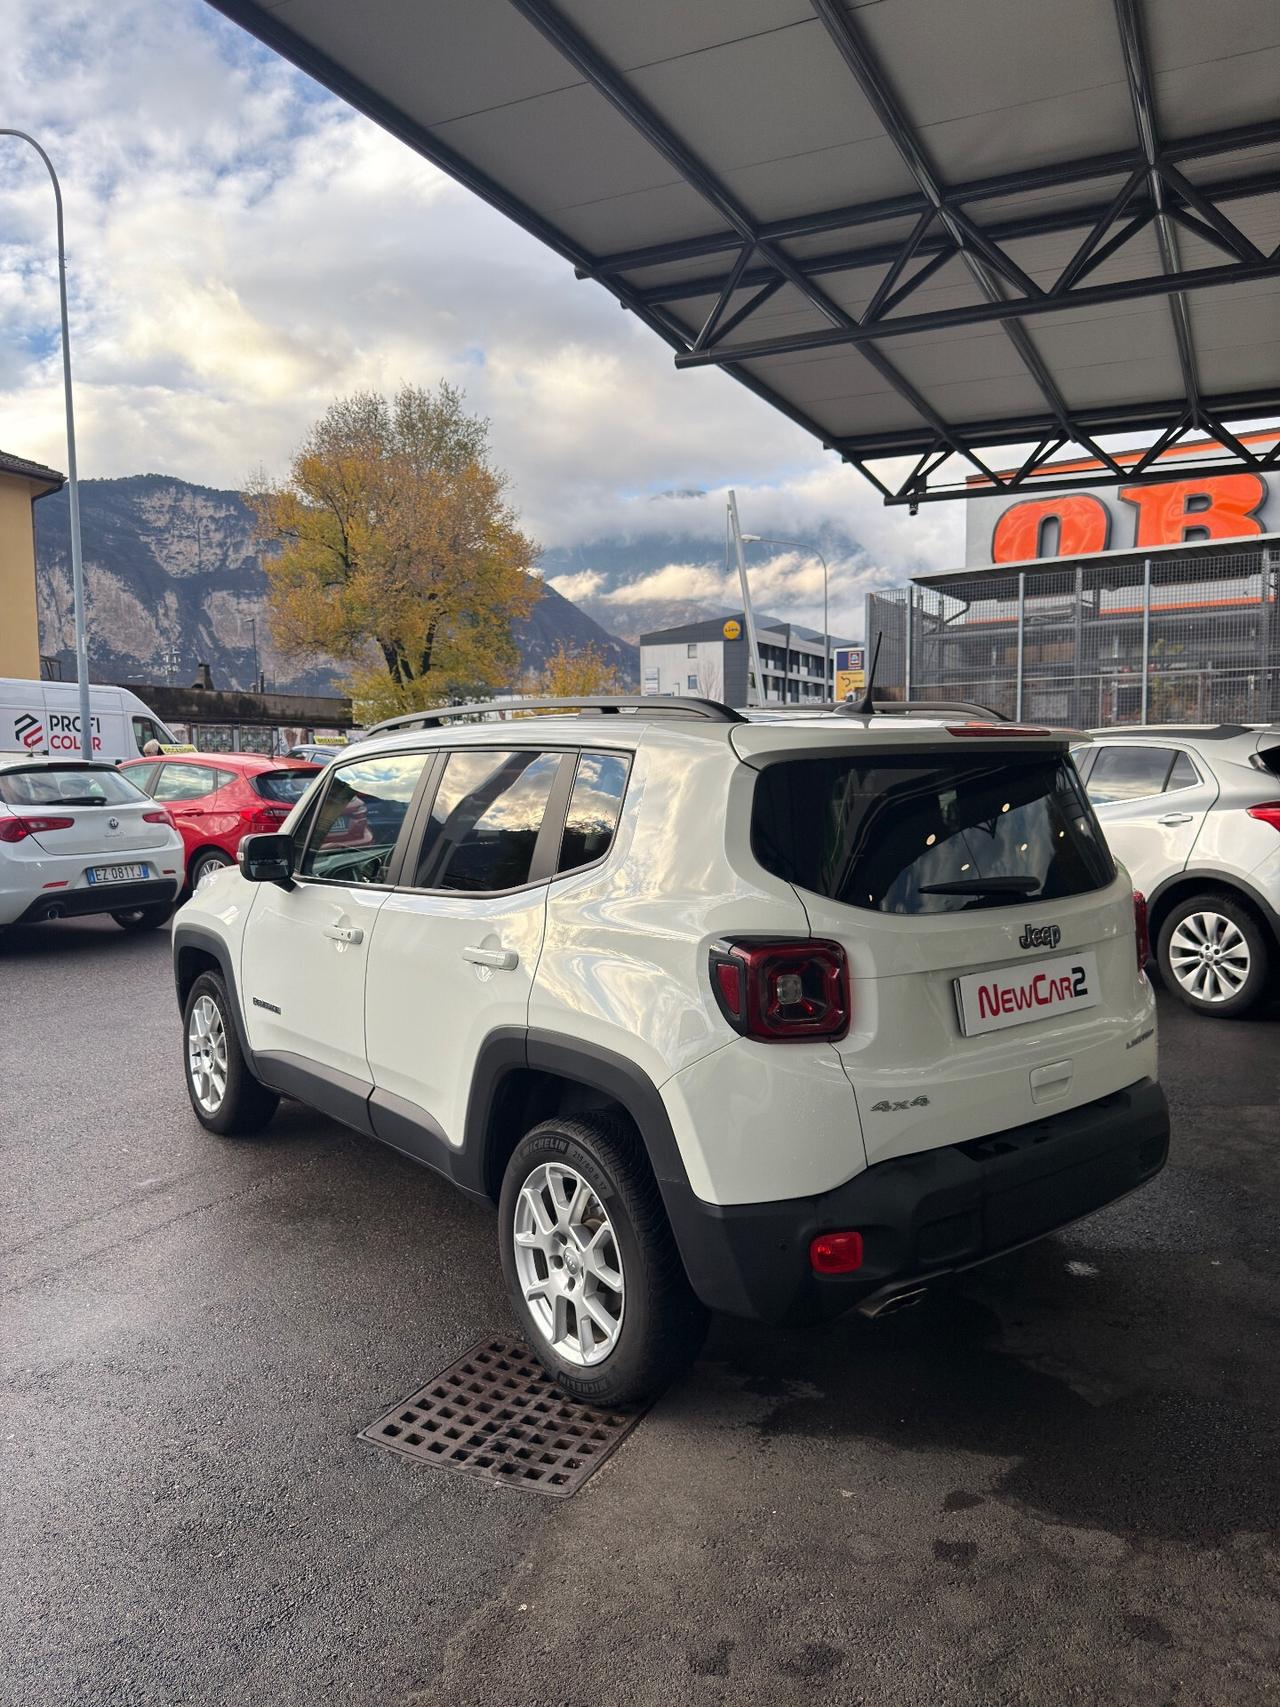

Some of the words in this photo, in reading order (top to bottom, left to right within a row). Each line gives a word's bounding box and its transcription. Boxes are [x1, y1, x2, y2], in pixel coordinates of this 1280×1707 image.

[50, 735, 102, 751] COLR
[95, 868, 109, 881] EZ
[111, 865, 142, 880] 081YJ
[1019, 924, 1061, 949] Jeep
